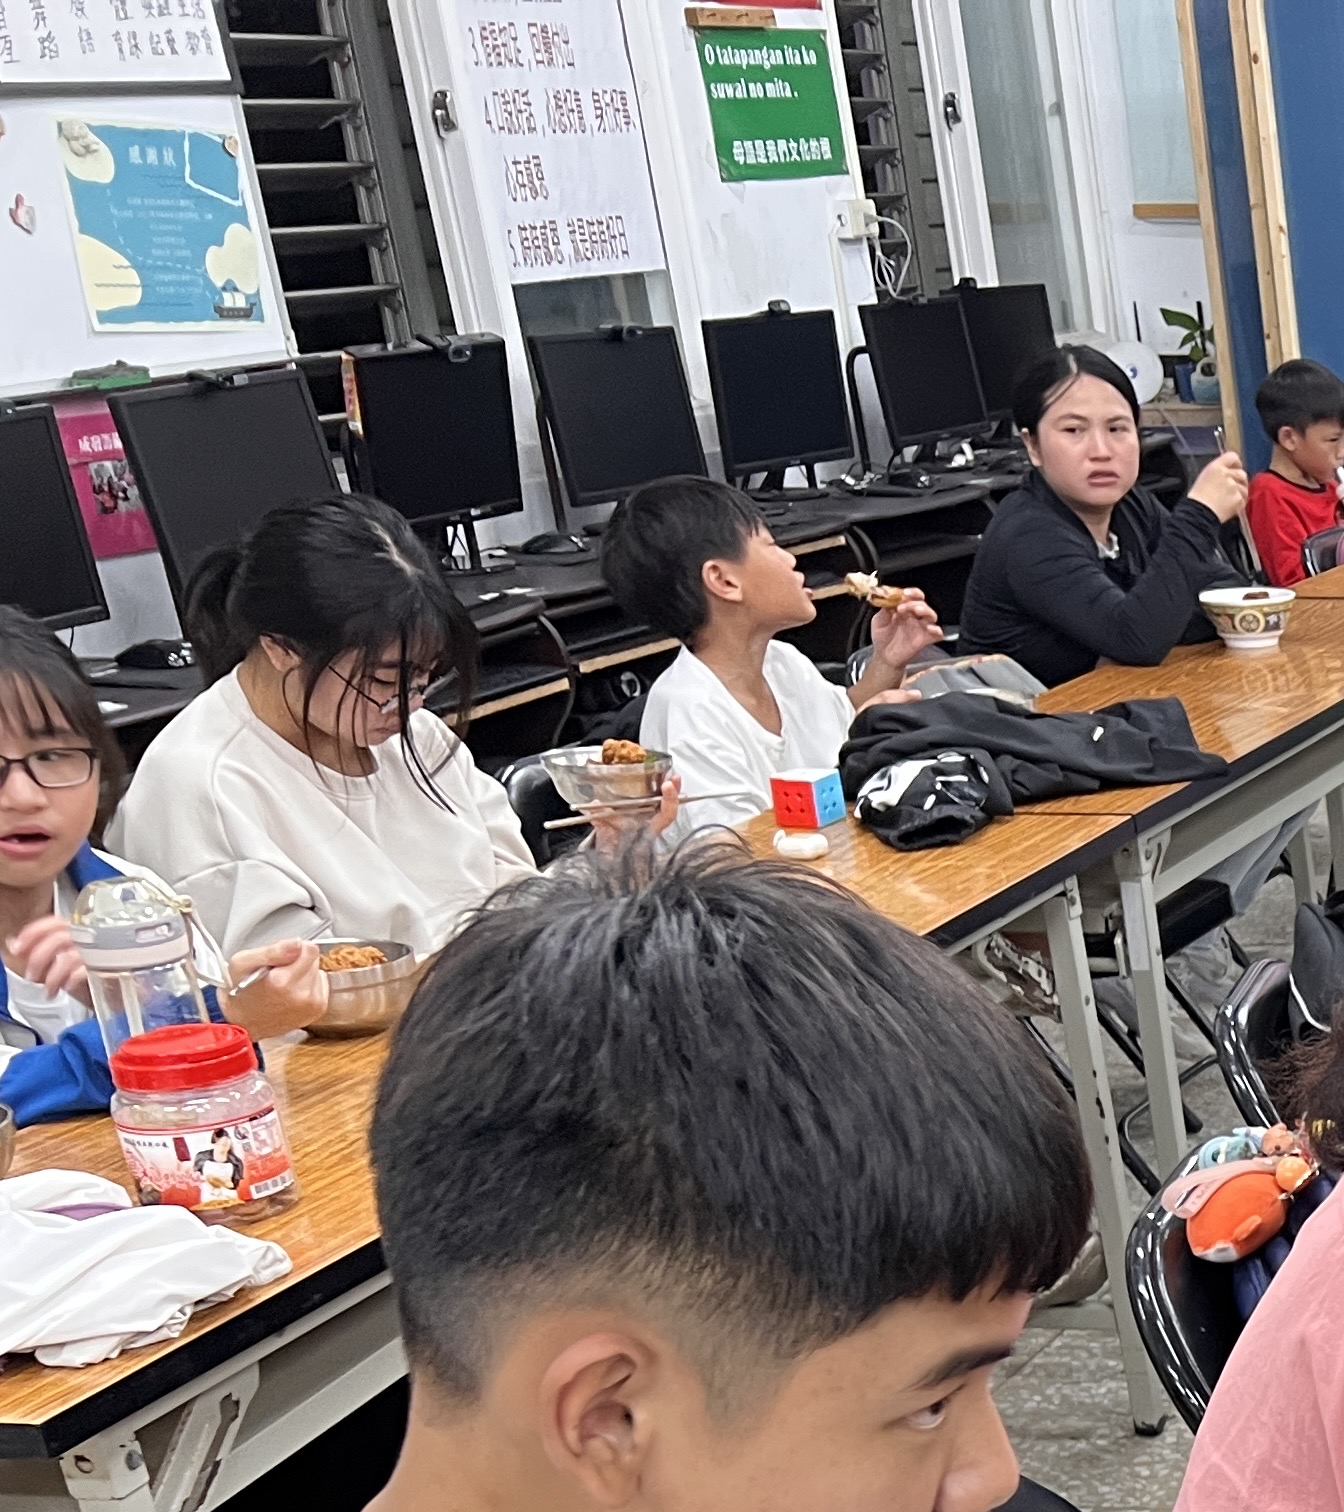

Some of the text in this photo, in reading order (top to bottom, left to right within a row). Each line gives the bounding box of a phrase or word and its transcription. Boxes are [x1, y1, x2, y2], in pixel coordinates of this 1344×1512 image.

[704, 43, 817, 69] O tatapangan ita ko
[710, 78, 748, 99] suwal
[748, 81, 765, 98] no
